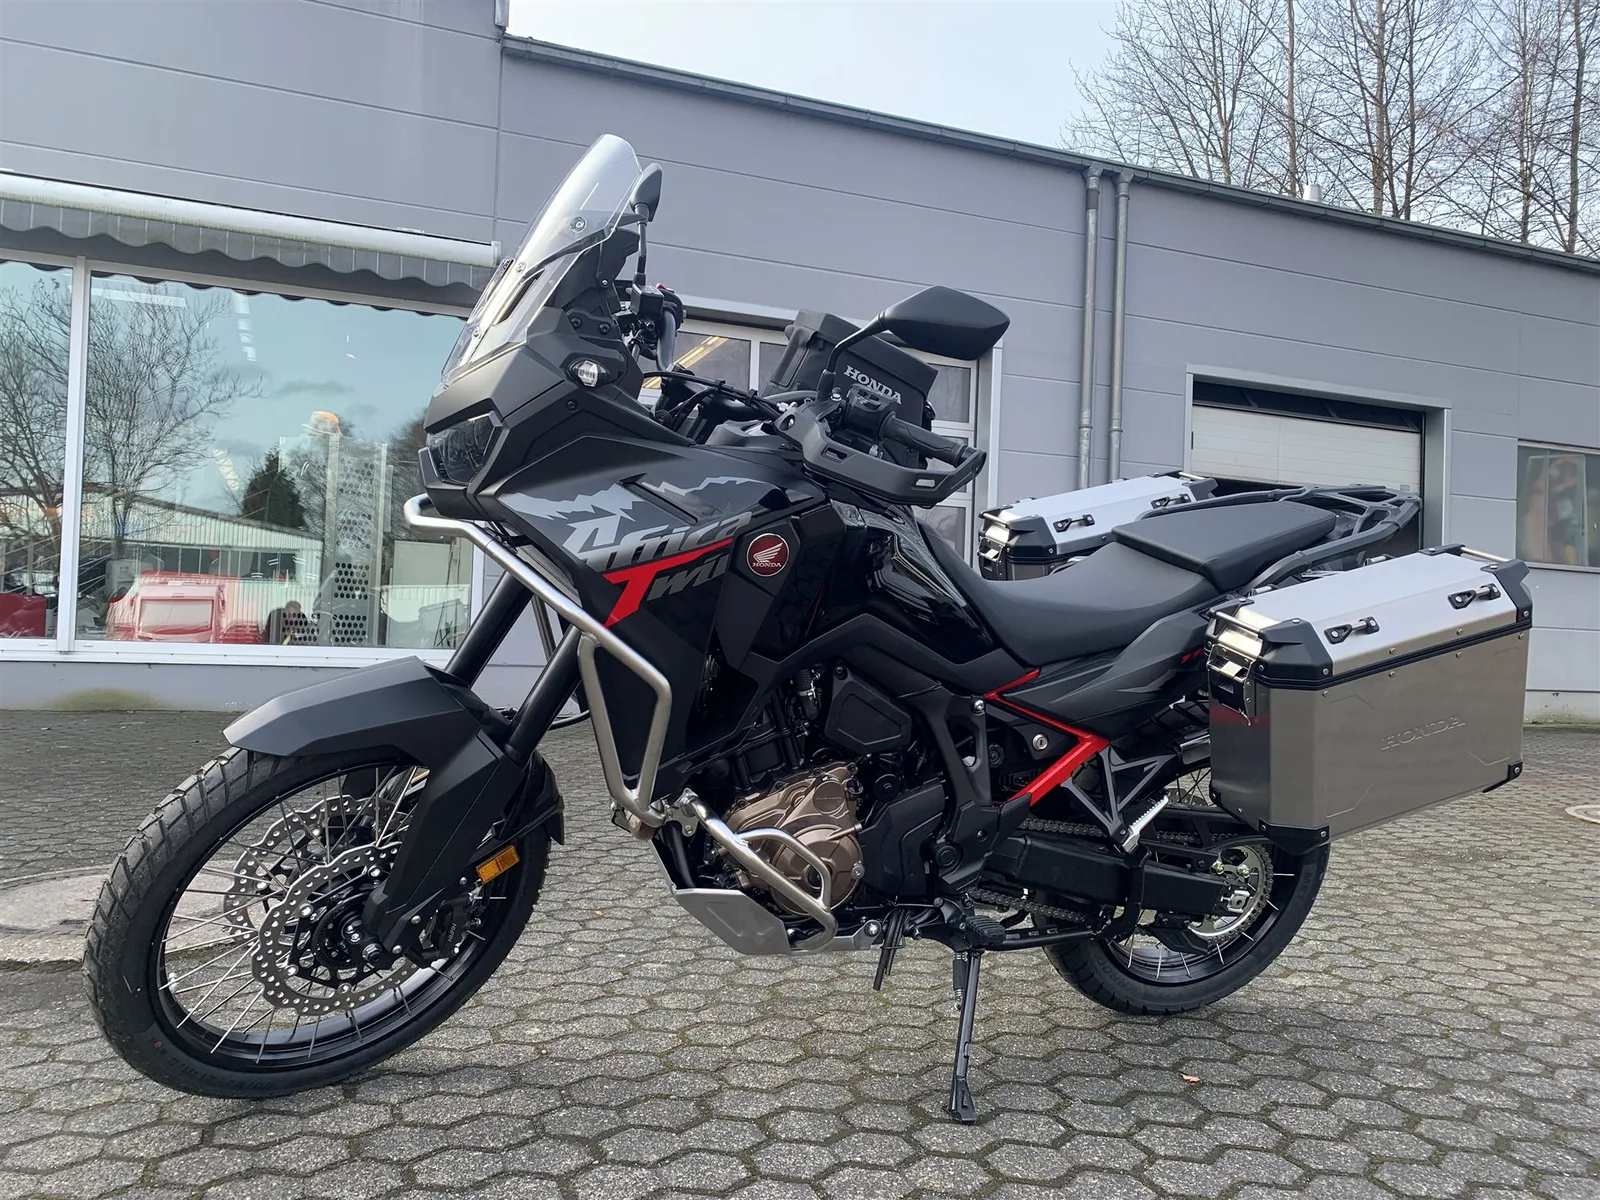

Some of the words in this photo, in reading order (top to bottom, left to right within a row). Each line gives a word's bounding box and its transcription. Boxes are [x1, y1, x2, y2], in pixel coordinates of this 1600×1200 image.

[844, 365, 902, 405] HONDA
[562, 511, 753, 573] Africa
[1382, 715, 1466, 751] HONDA
